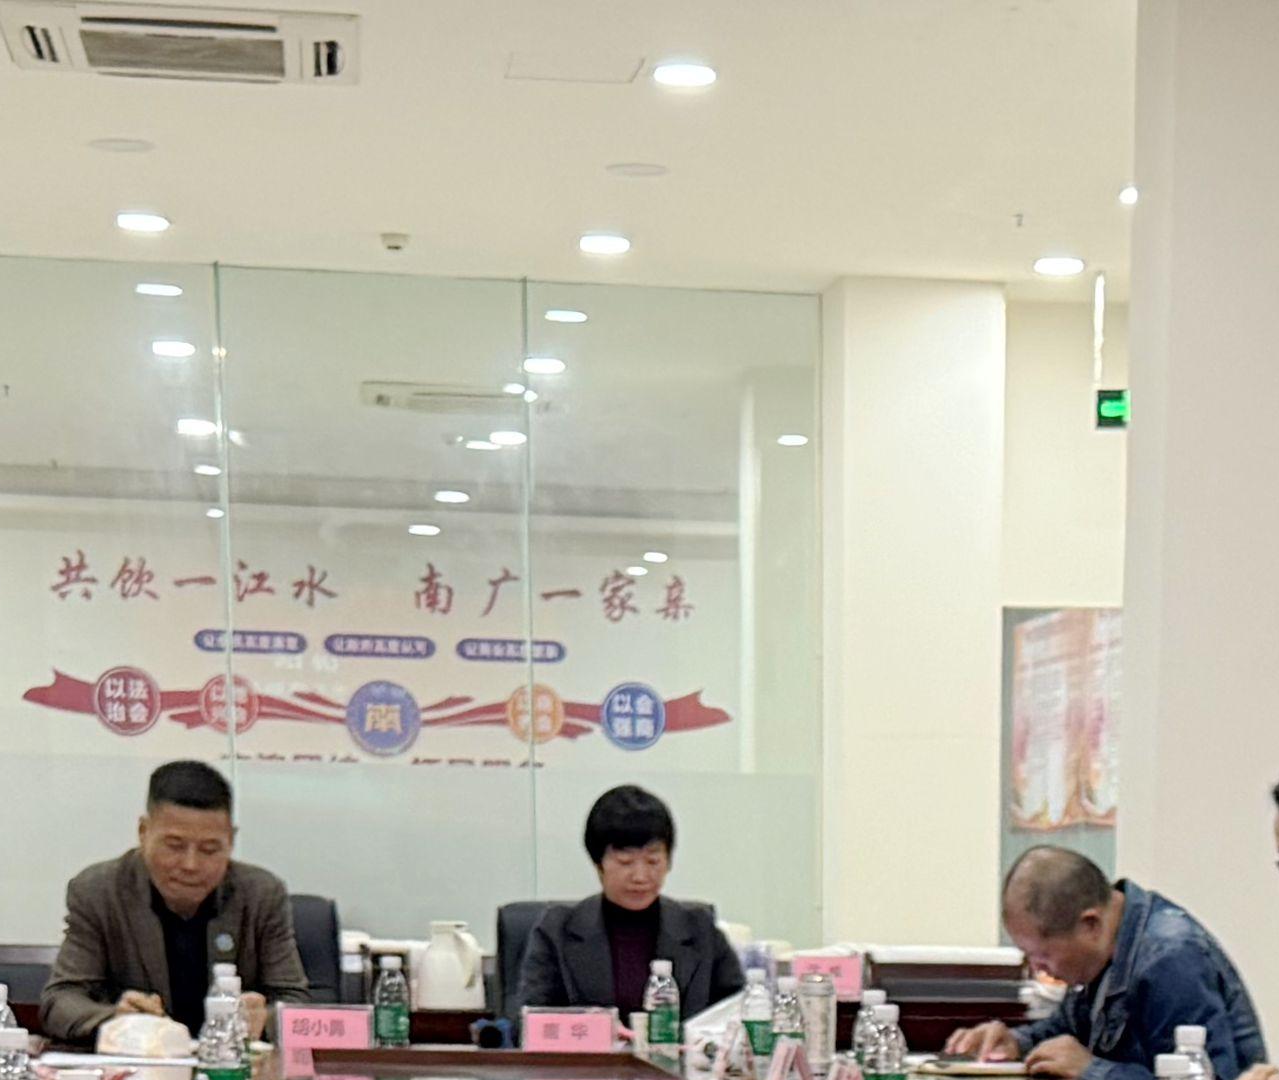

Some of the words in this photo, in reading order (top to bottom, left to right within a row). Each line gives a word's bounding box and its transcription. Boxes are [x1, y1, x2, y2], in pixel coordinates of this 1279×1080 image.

[51, 550, 338, 607] 共饮一江水
[414, 562, 694, 623] 南广一家亲
